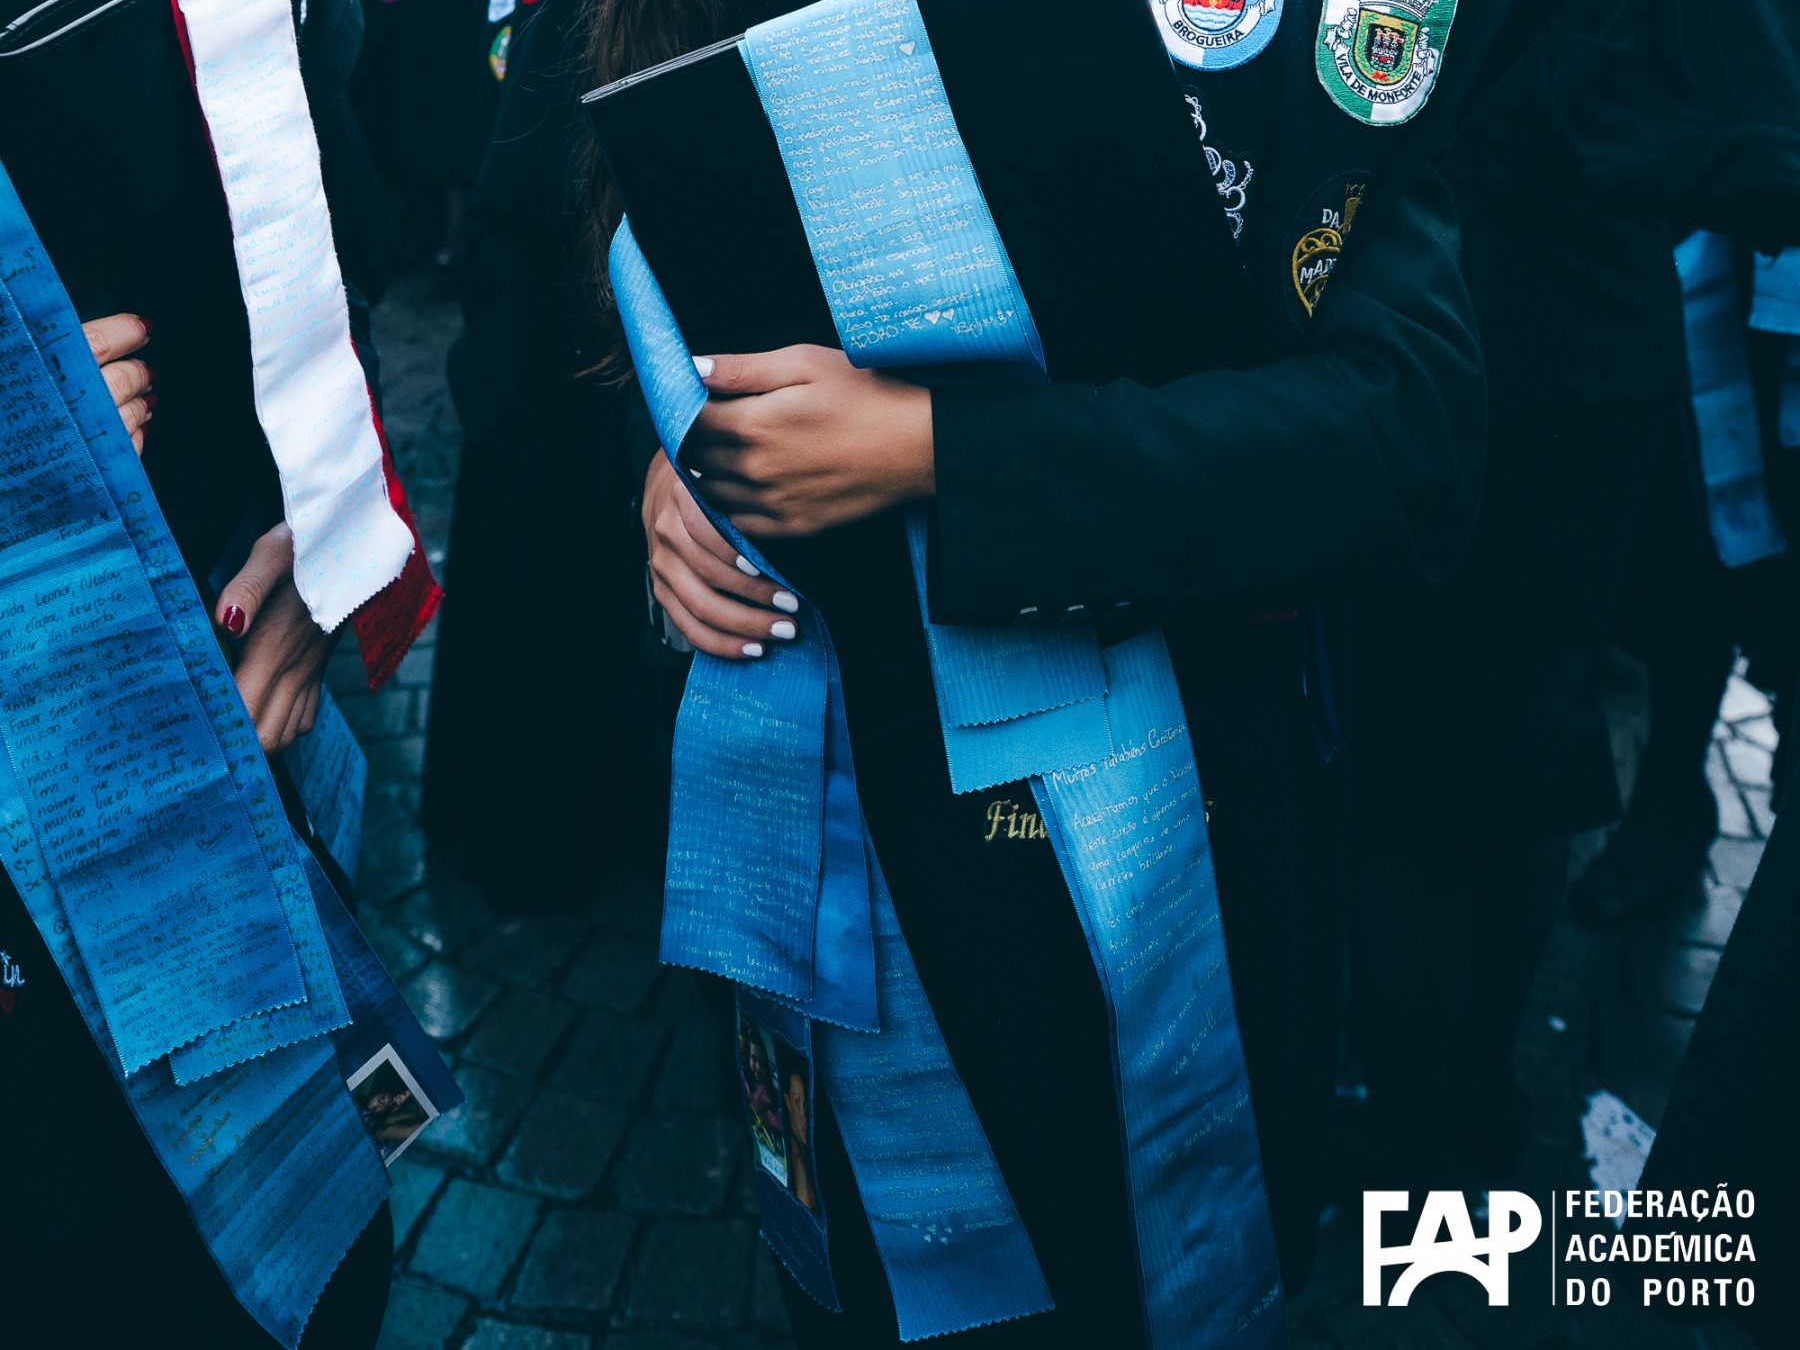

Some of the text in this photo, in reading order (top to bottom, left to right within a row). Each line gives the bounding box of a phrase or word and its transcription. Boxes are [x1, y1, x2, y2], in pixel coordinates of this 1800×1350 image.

[1172, 20, 1244, 46] BROGUEIRA
[1337, 53, 1422, 102] VILA DE MONFORTE
[1322, 209, 1340, 228] DA
[1052, 764, 1097, 792] Muitos
[1073, 778, 1168, 830] Acreditamos que o
